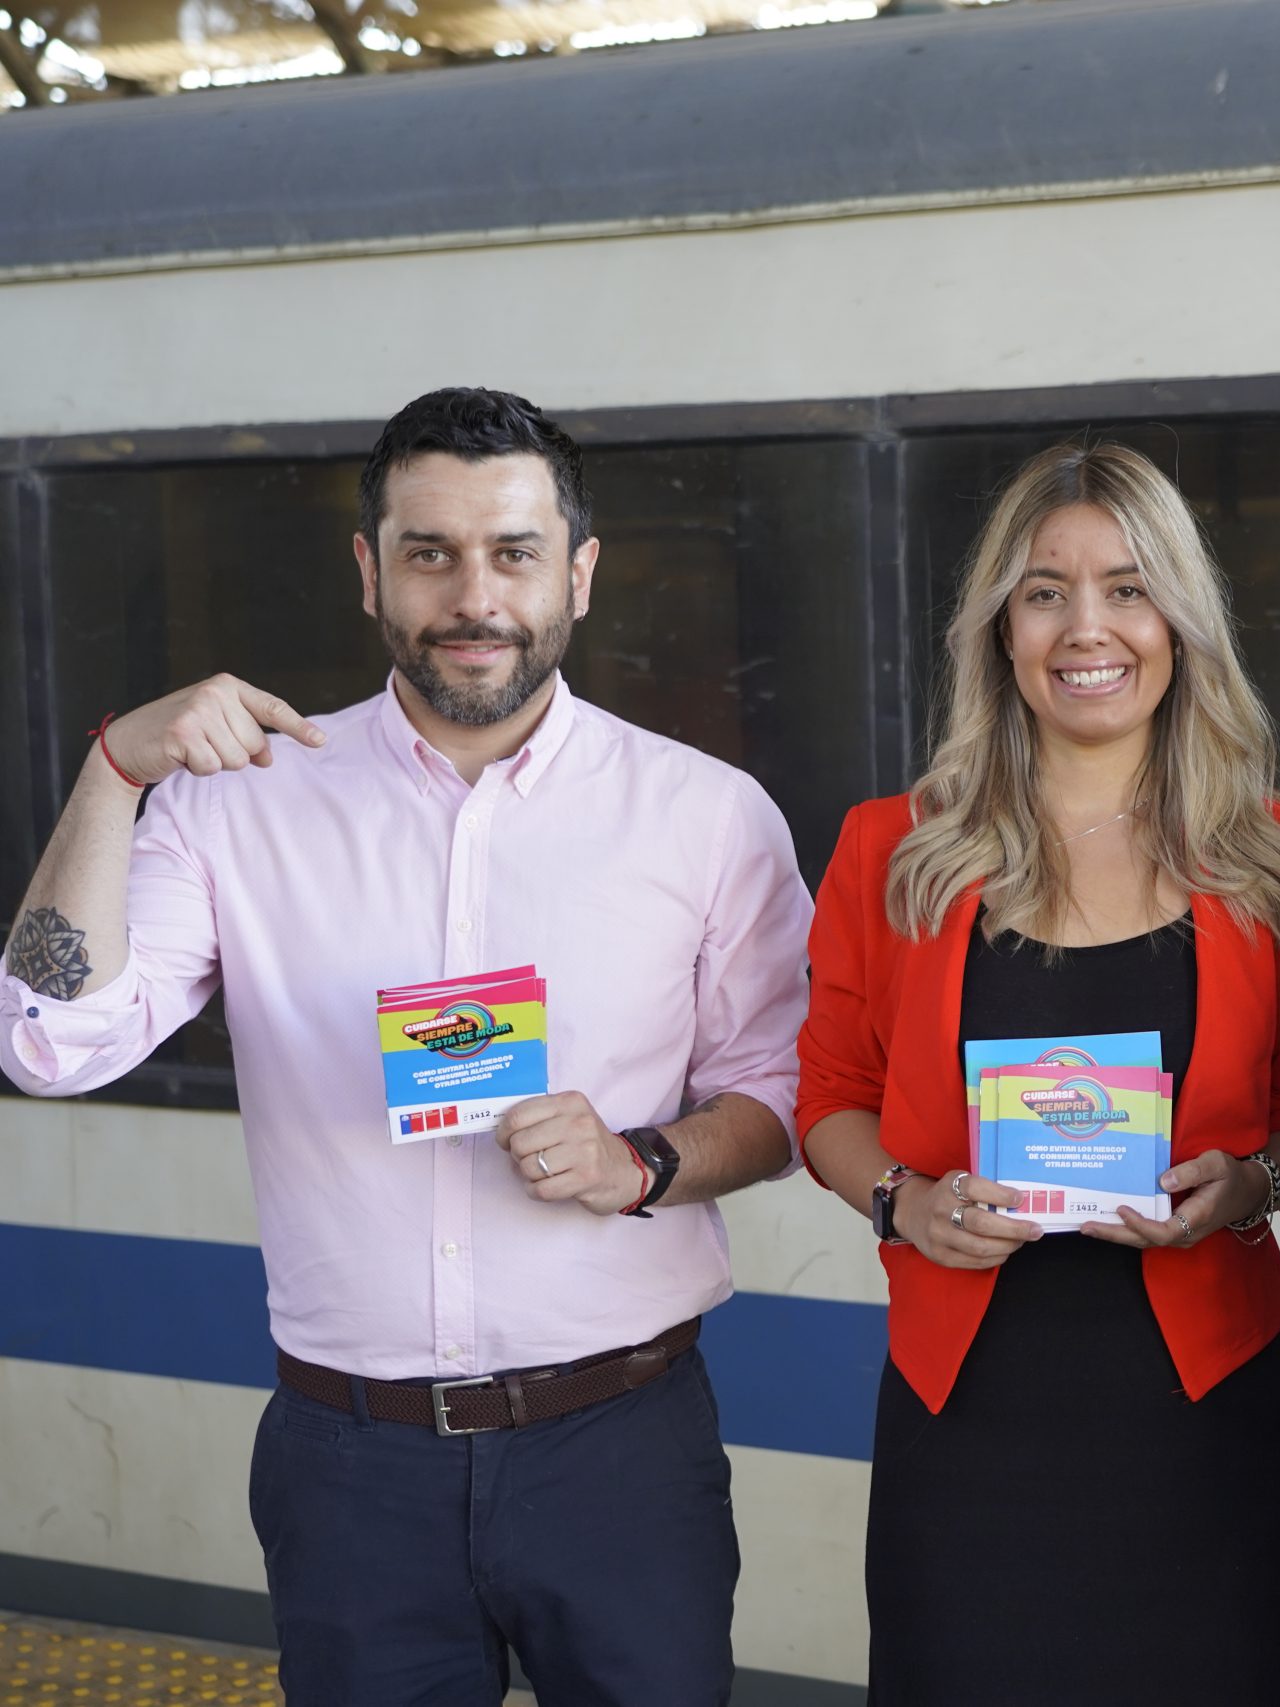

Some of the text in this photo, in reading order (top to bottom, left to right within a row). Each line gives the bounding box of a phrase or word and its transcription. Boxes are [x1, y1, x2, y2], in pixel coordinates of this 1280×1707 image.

[404, 1014, 458, 1033] CUIDARSE
[416, 1022, 474, 1041] SIEMPRE
[458, 1032, 474, 1042] DE
[476, 1024, 510, 1038] MODA
[438, 1064, 465, 1074] EVITAR
[465, 1060, 480, 1070] LOS
[480, 1054, 514, 1066] RIESGOS
[428, 1070, 470, 1083] CONSUMIR
[470, 1064, 504, 1076] ALCOHOL
[434, 1072, 492, 1088] OTRAS DROGAS
[1022, 1090, 1075, 1100] CUIDARSE
[1034, 1101, 1090, 1112] SIEMPRE
[470, 1110, 490, 1120] 1412
[1074, 1112, 1089, 1120] DE
[1092, 1110, 1126, 1120] MODA
[1077, 1204, 1098, 1212] 1412
